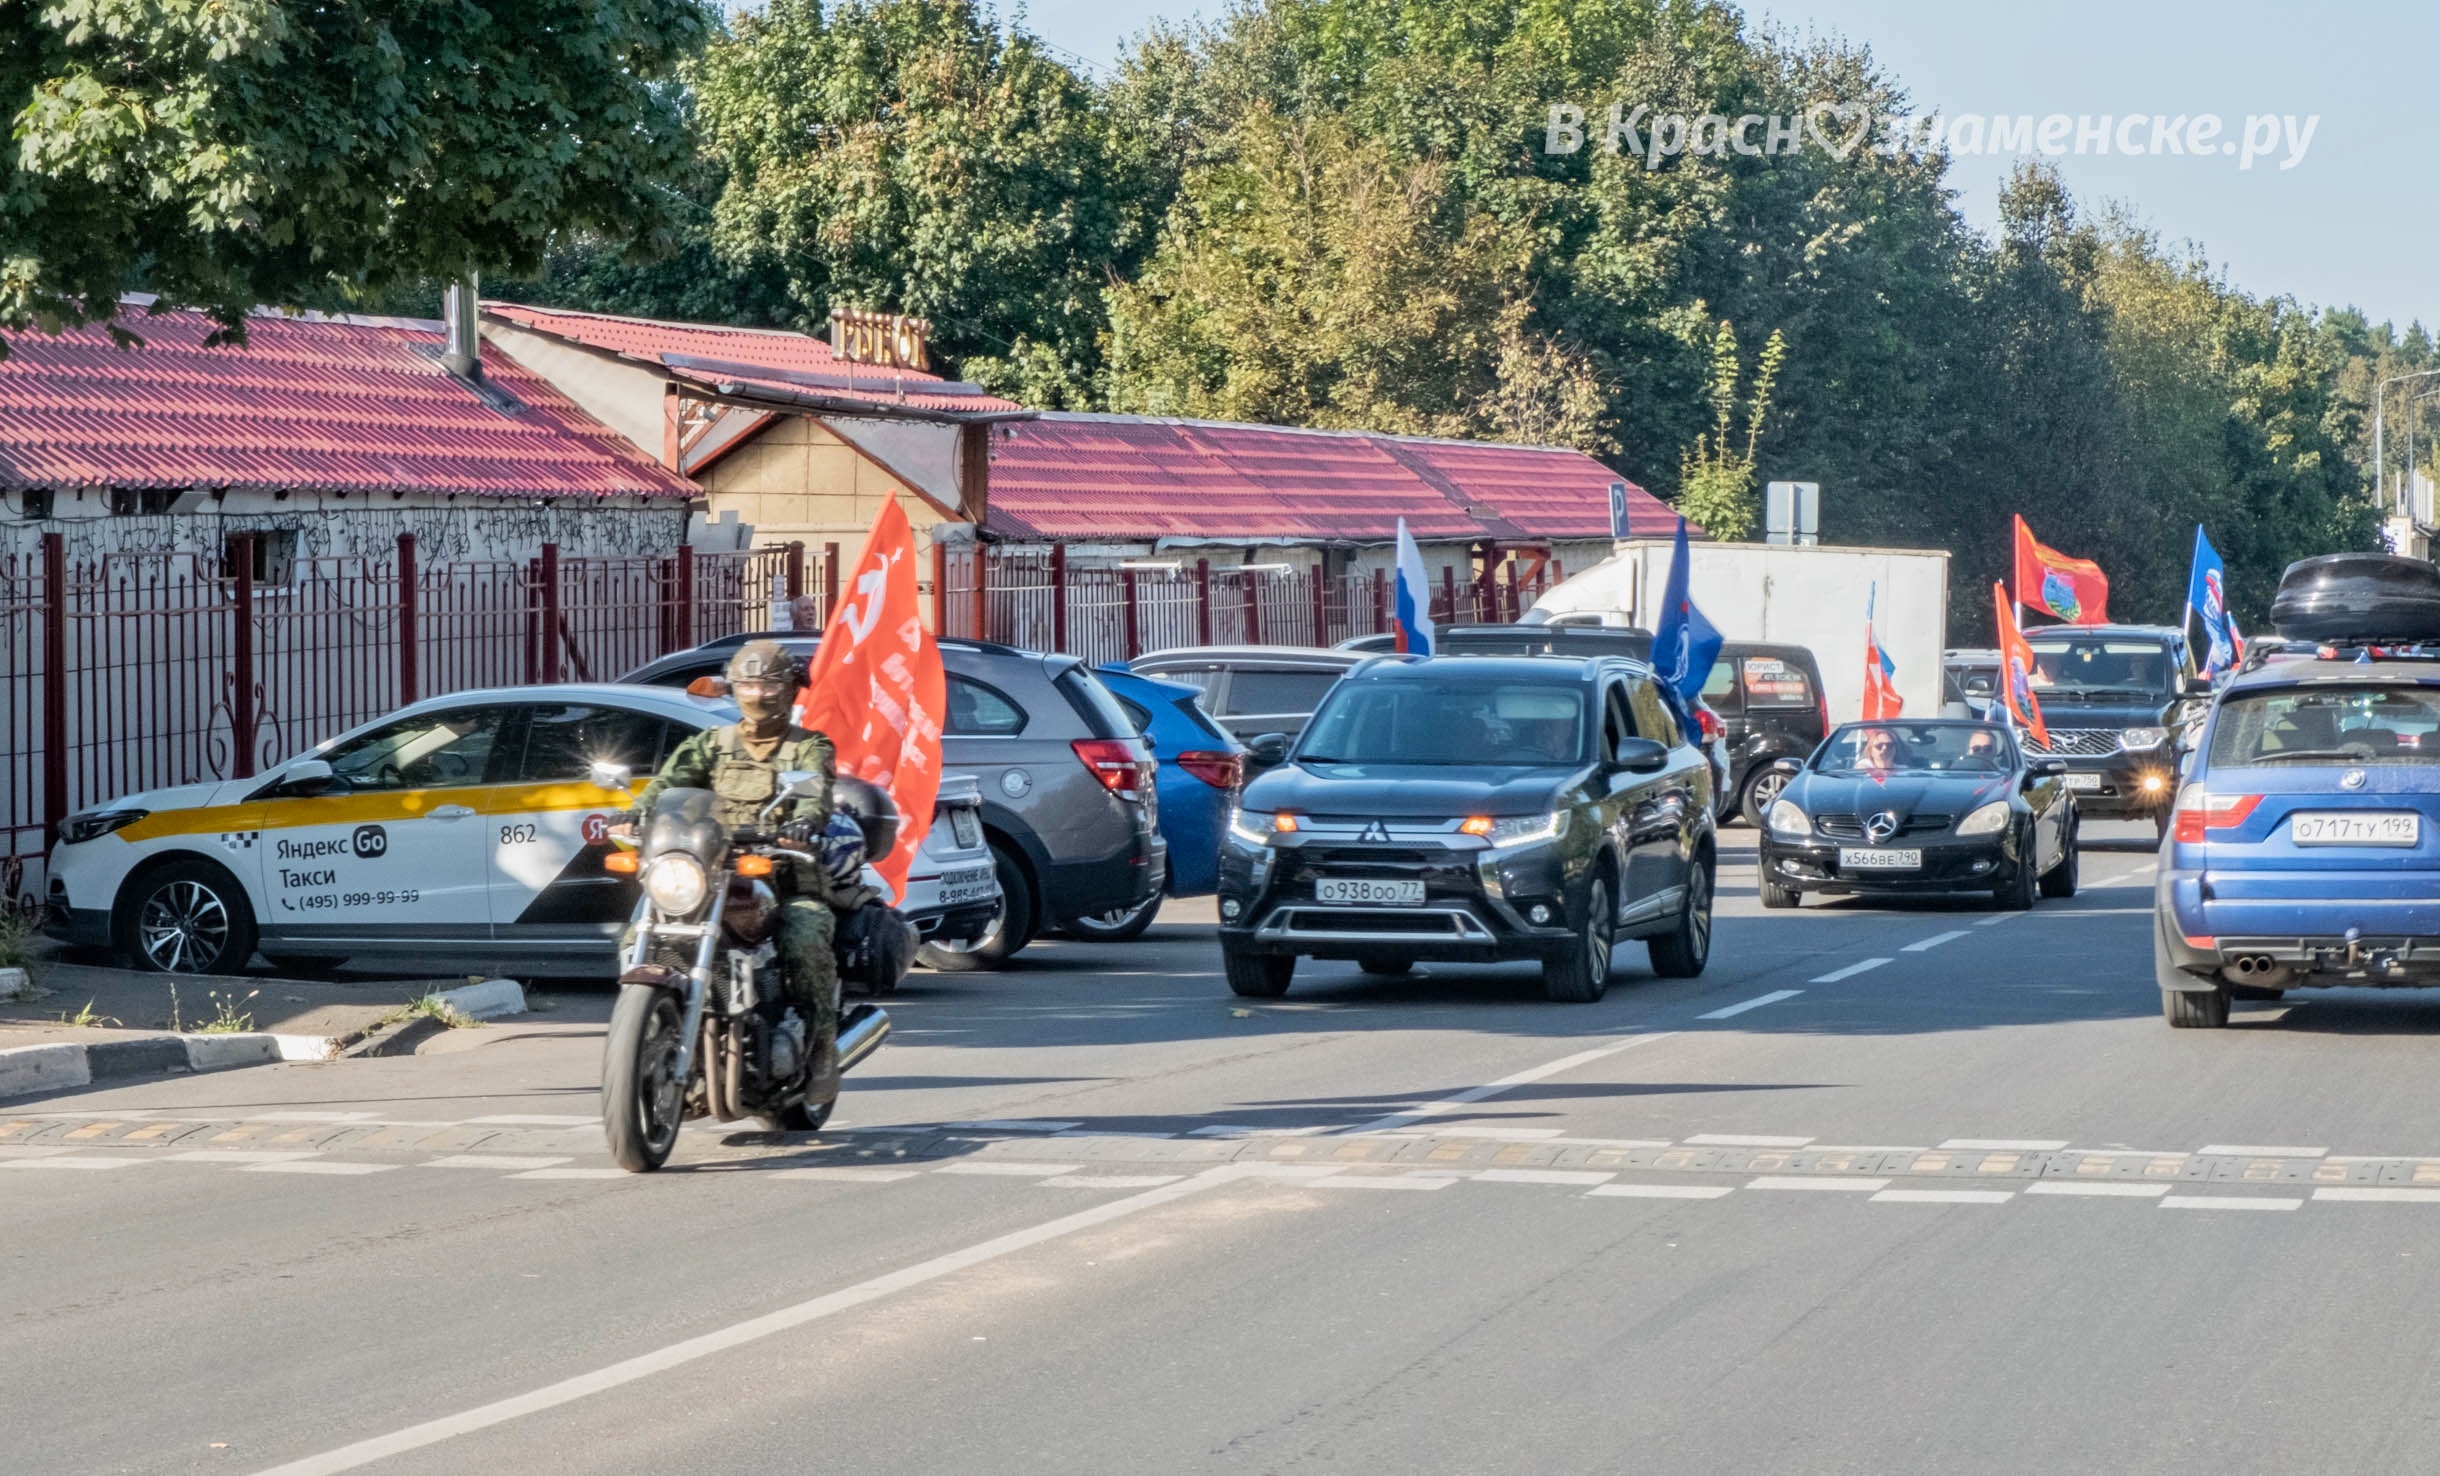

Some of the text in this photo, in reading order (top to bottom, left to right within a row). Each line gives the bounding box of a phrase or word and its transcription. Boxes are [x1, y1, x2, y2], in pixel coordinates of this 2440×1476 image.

[1614, 489, 1624, 532] P
[1747, 662, 1782, 672] ЮРИСТ
[500, 823, 537, 845] 862
[2299, 818, 2413, 838] О717ТУ 199
[277, 830, 386, 860] Яндекс Go
[1845, 851, 1918, 866] Х566ВЕ 790
[279, 868, 337, 889] Такси
[299, 889, 420, 912] (495) 999-99-99
[1323, 881, 1419, 900] О938ОО 77
